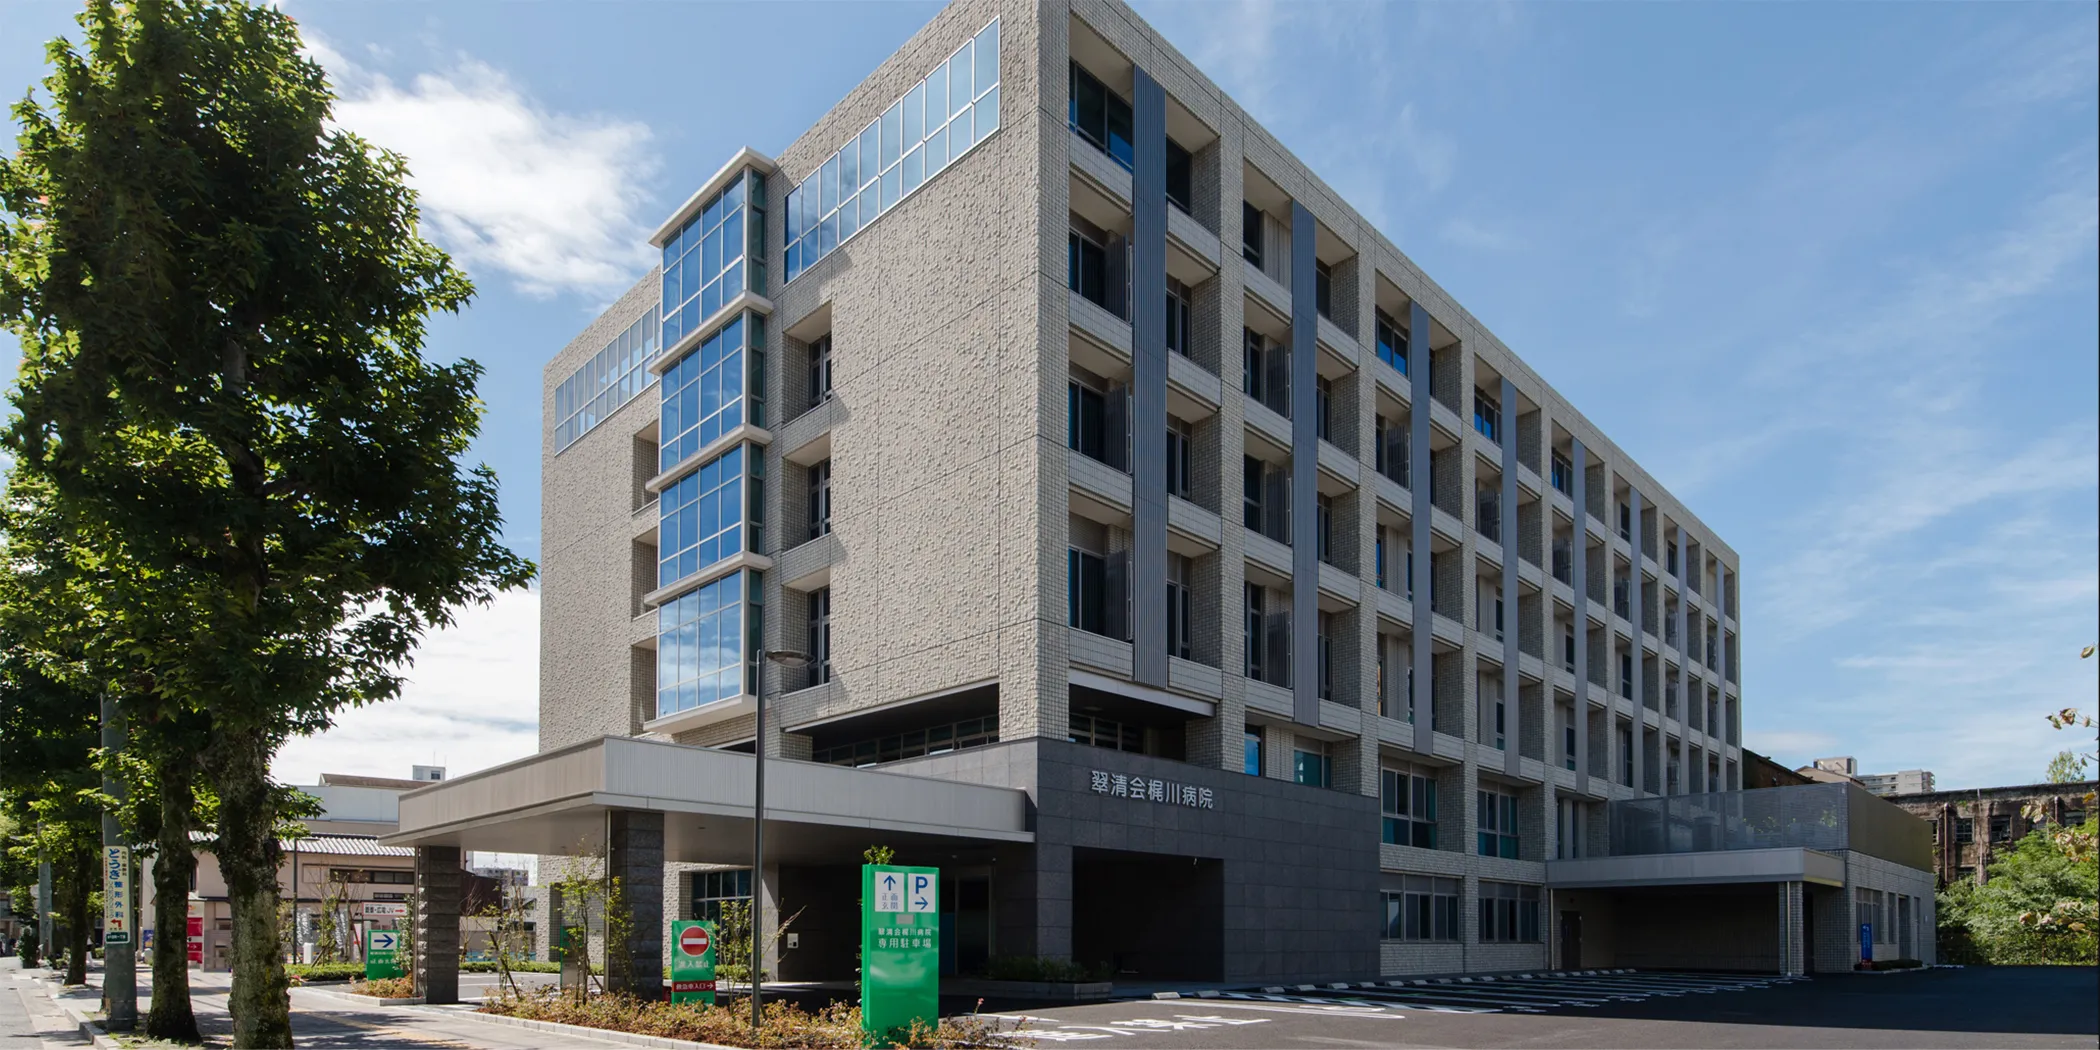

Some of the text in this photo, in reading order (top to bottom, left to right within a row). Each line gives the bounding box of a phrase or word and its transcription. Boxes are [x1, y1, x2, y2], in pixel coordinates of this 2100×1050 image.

[1091, 770, 1213, 809] 翠清会梶川病院
[915, 876, 928, 894] P
[878, 927, 932, 936] 翠清会梶川病院
[878, 938, 932, 948] 専用駐車場
